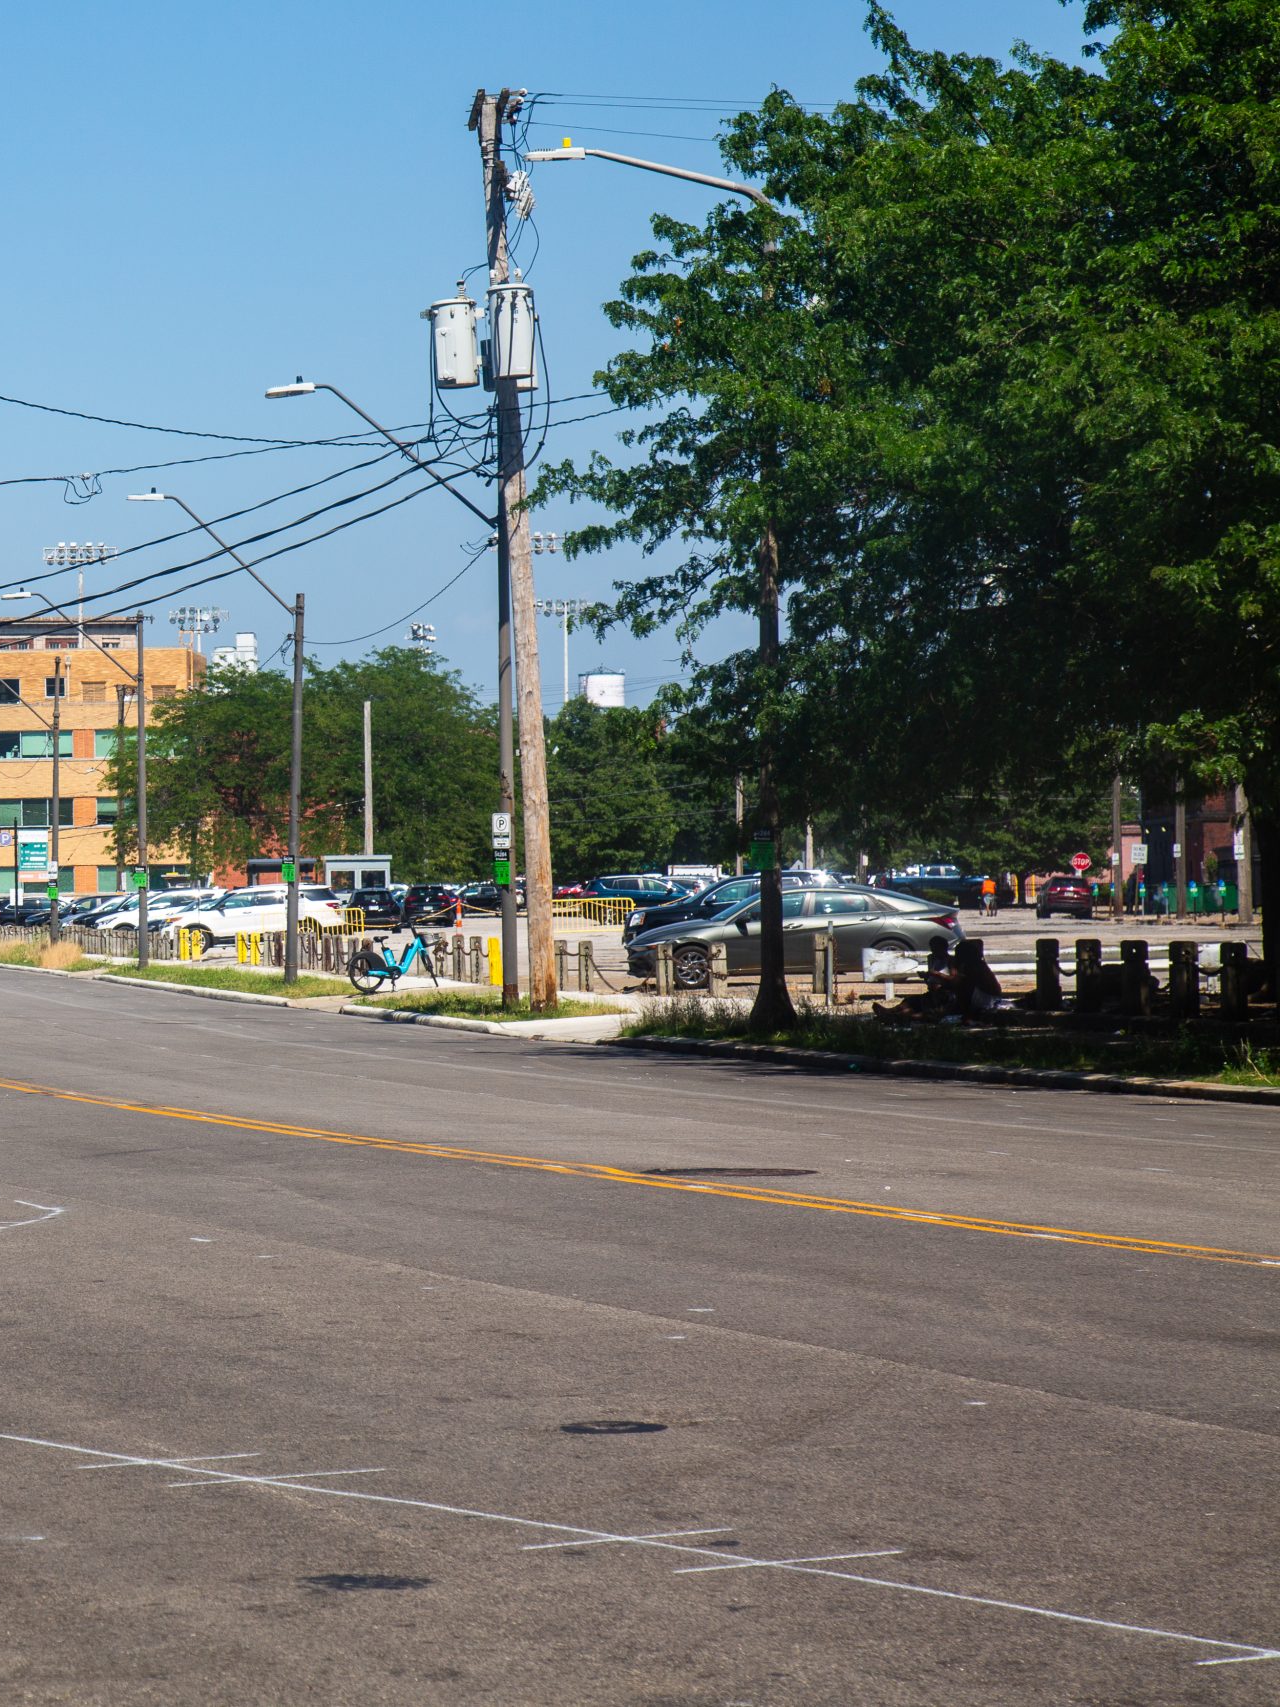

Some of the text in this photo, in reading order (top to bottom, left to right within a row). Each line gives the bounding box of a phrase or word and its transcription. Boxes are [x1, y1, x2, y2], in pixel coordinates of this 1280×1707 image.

[499, 819, 505, 828] P
[1, 834, 10, 844] P
[1074, 858, 1090, 866] STOP
